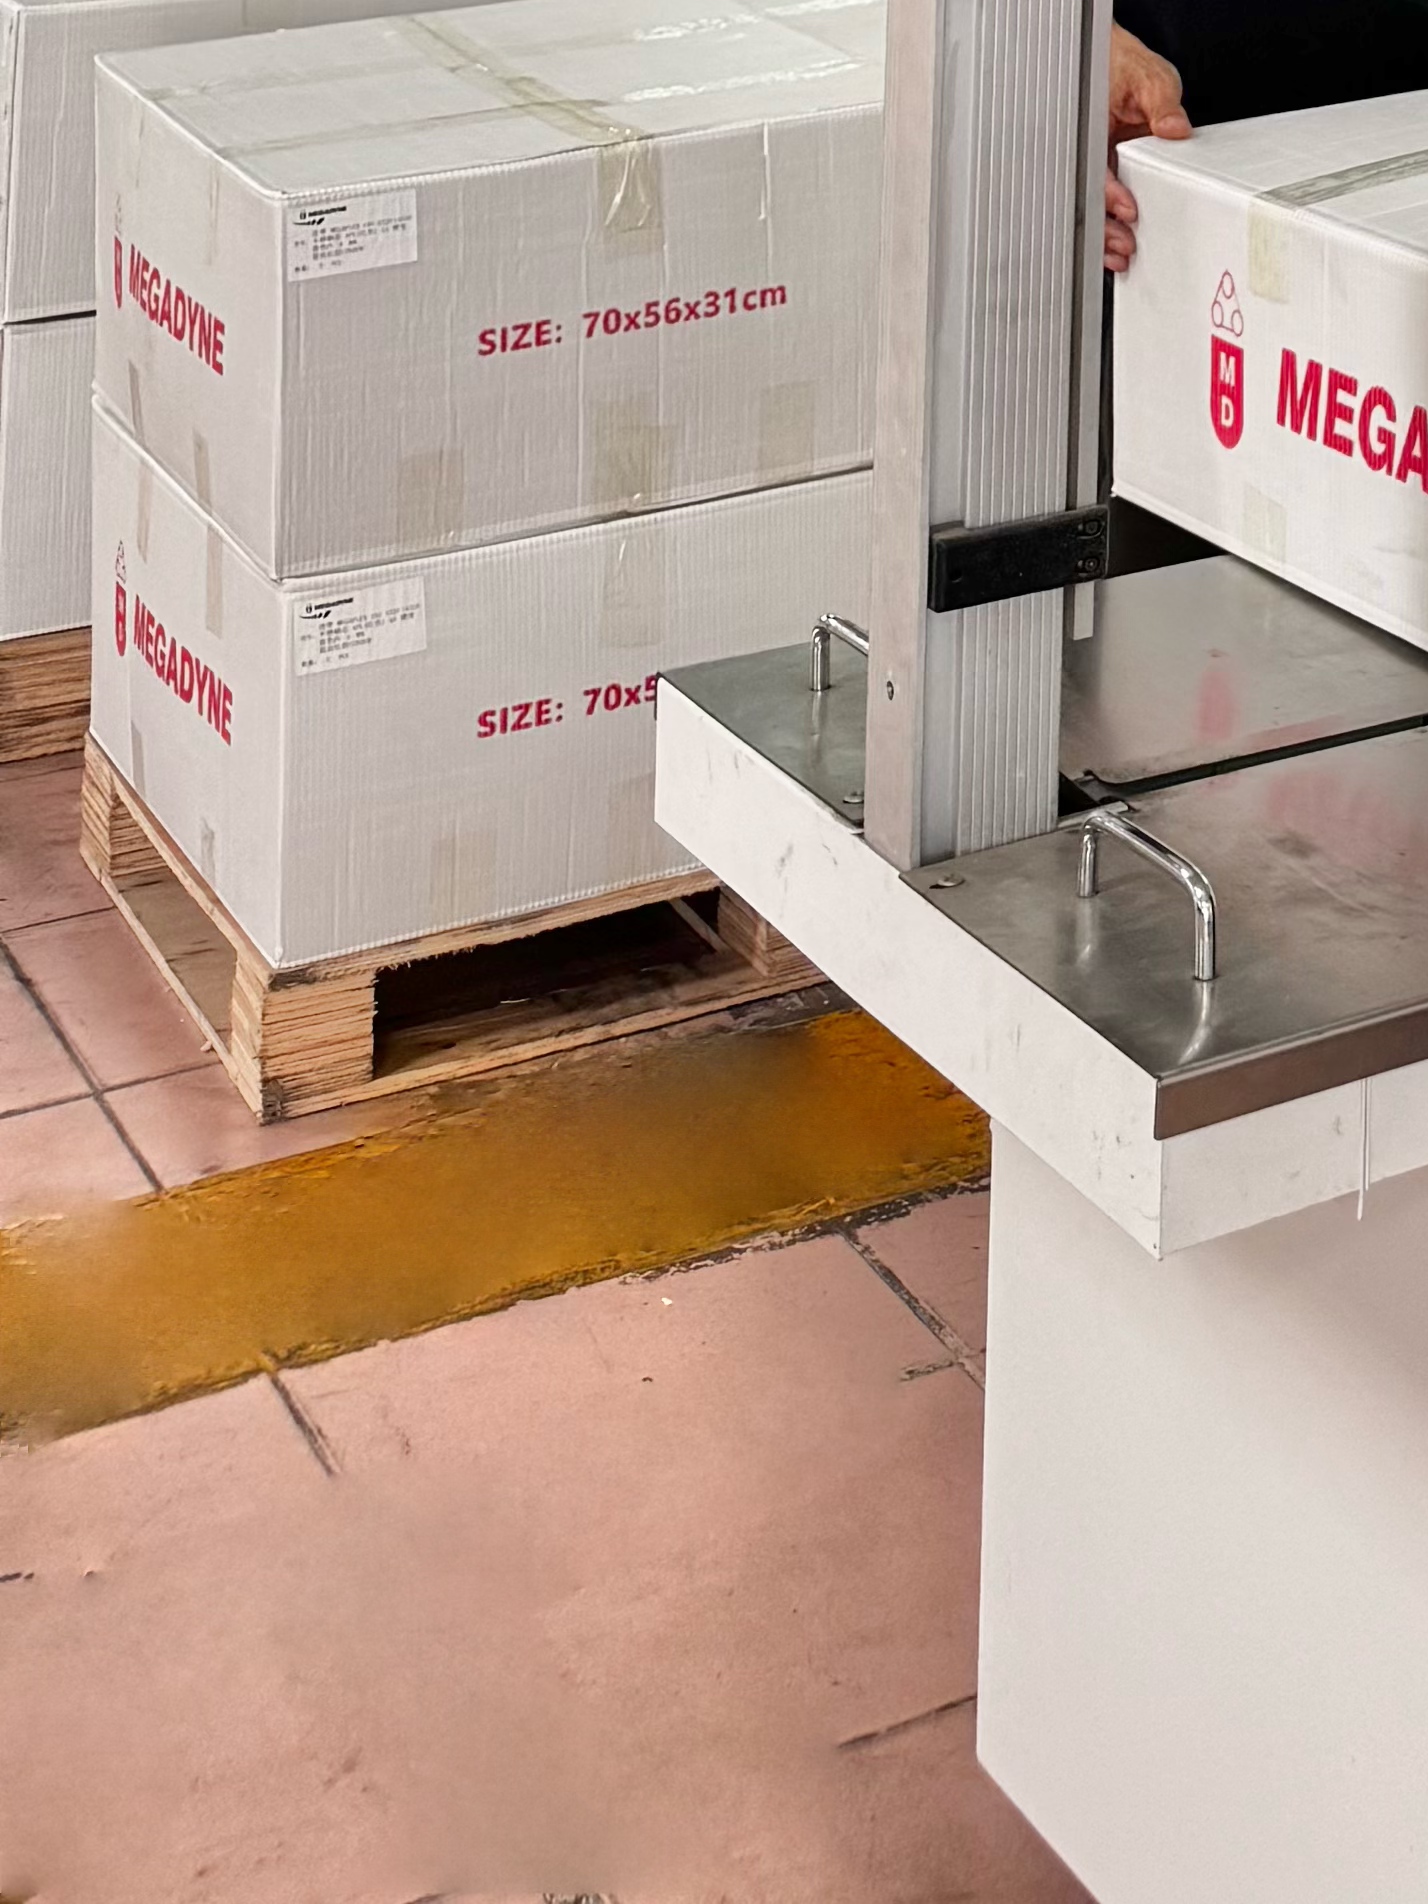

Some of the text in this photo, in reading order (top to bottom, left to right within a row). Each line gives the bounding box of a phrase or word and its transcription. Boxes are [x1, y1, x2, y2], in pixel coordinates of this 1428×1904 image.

[128, 242, 226, 377] MEGADYNE
[477, 283, 789, 358] SIZE: 70x56x31cm
[133, 593, 233, 747] MEGADYNE
[476, 697, 564, 739] SIZE:
